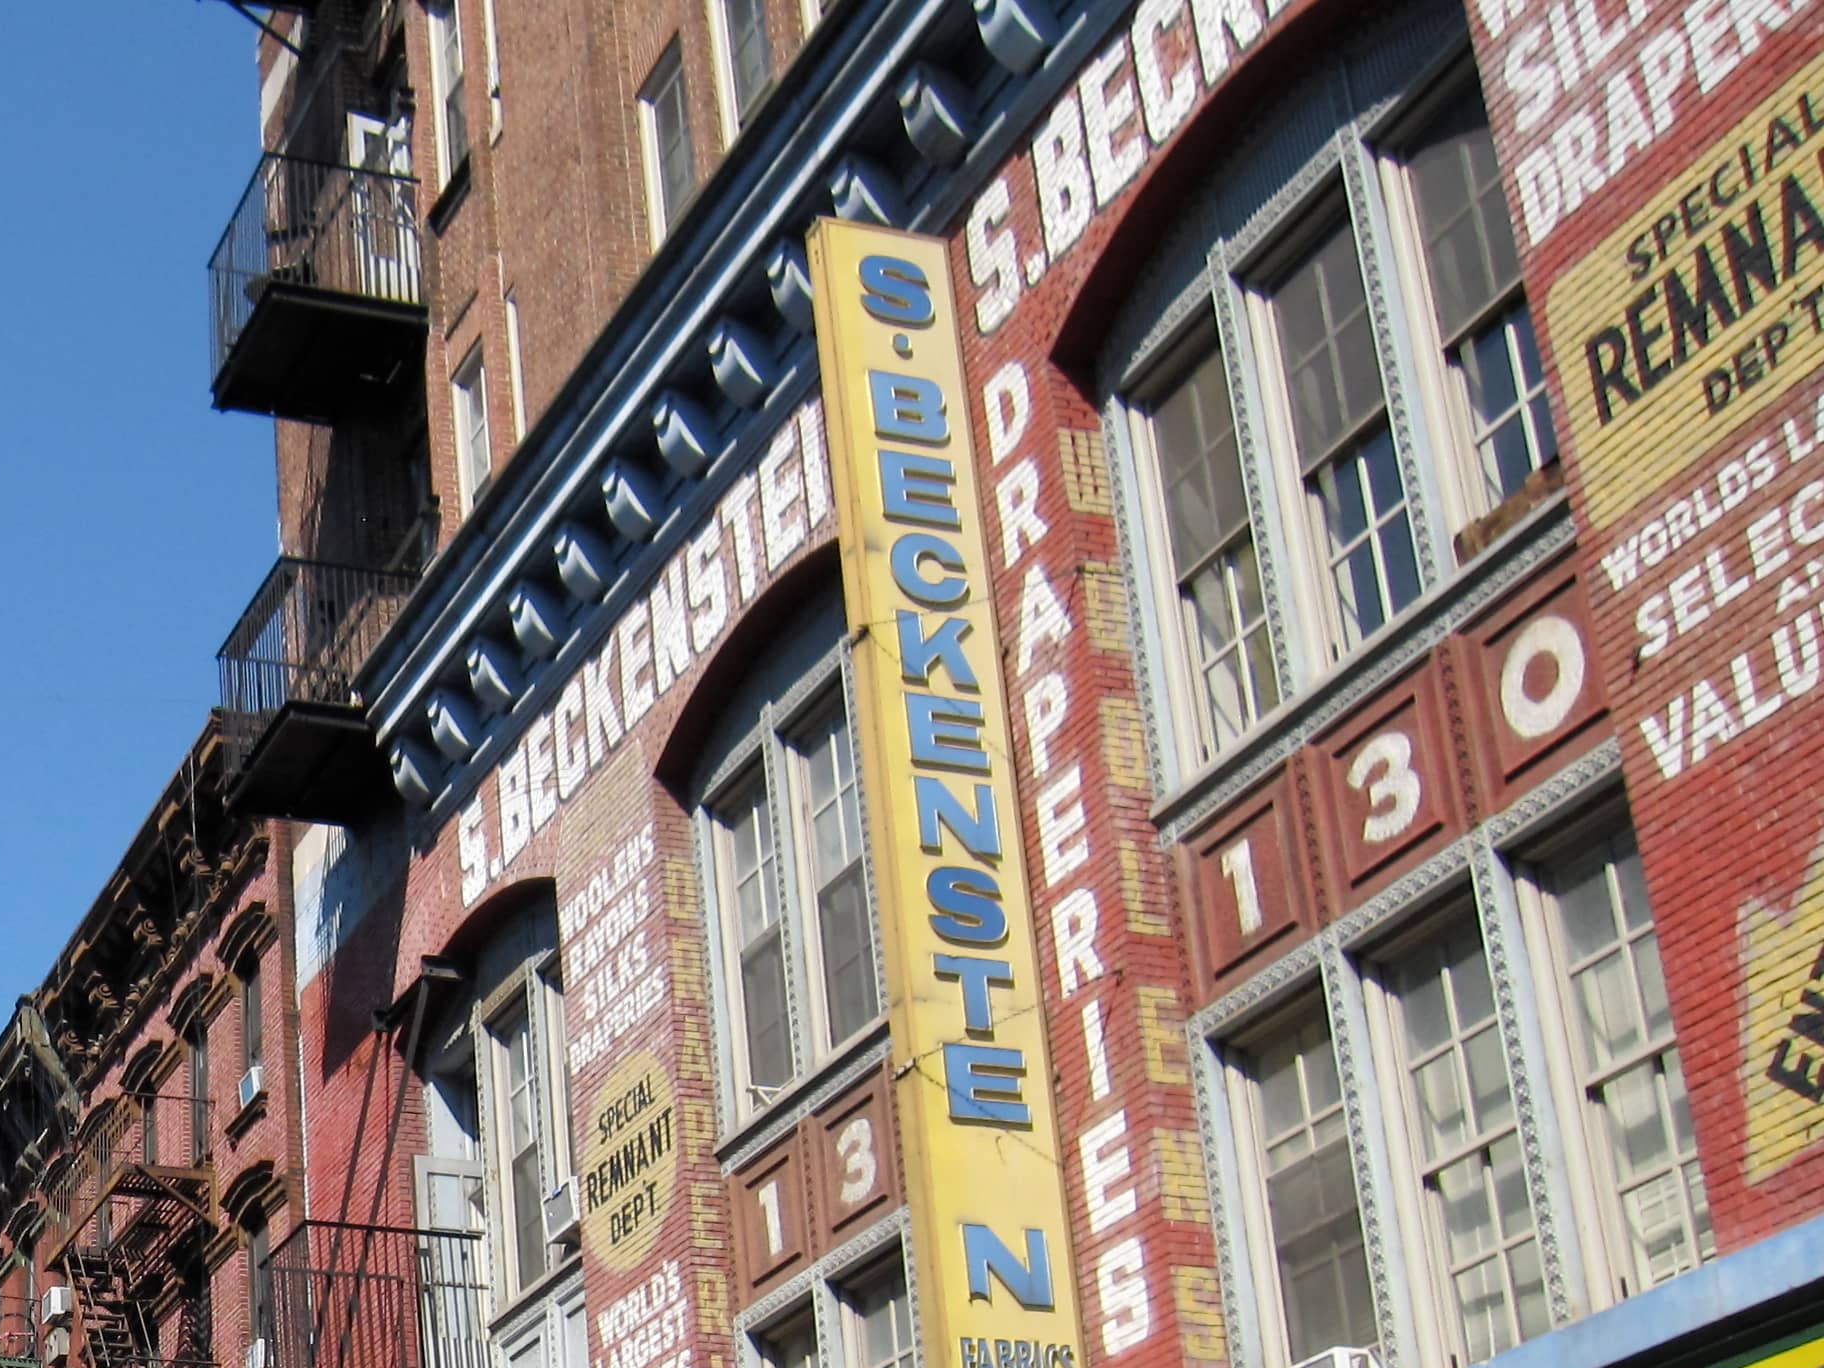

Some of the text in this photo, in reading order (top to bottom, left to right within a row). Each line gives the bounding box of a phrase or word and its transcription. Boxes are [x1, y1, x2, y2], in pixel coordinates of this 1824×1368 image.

[1584, 147, 1824, 428] REMNA
[1600, 436, 1776, 592] WORLDS
[558, 822, 656, 944] WOOLENS
[982, 360, 1152, 1357] DRAPERIES
[584, 930, 649, 1021] SILKS
[586, 1107, 673, 1214] REMNANT
[597, 1073, 657, 1146] SPECIAL
[597, 1259, 681, 1349] WORLD'S
